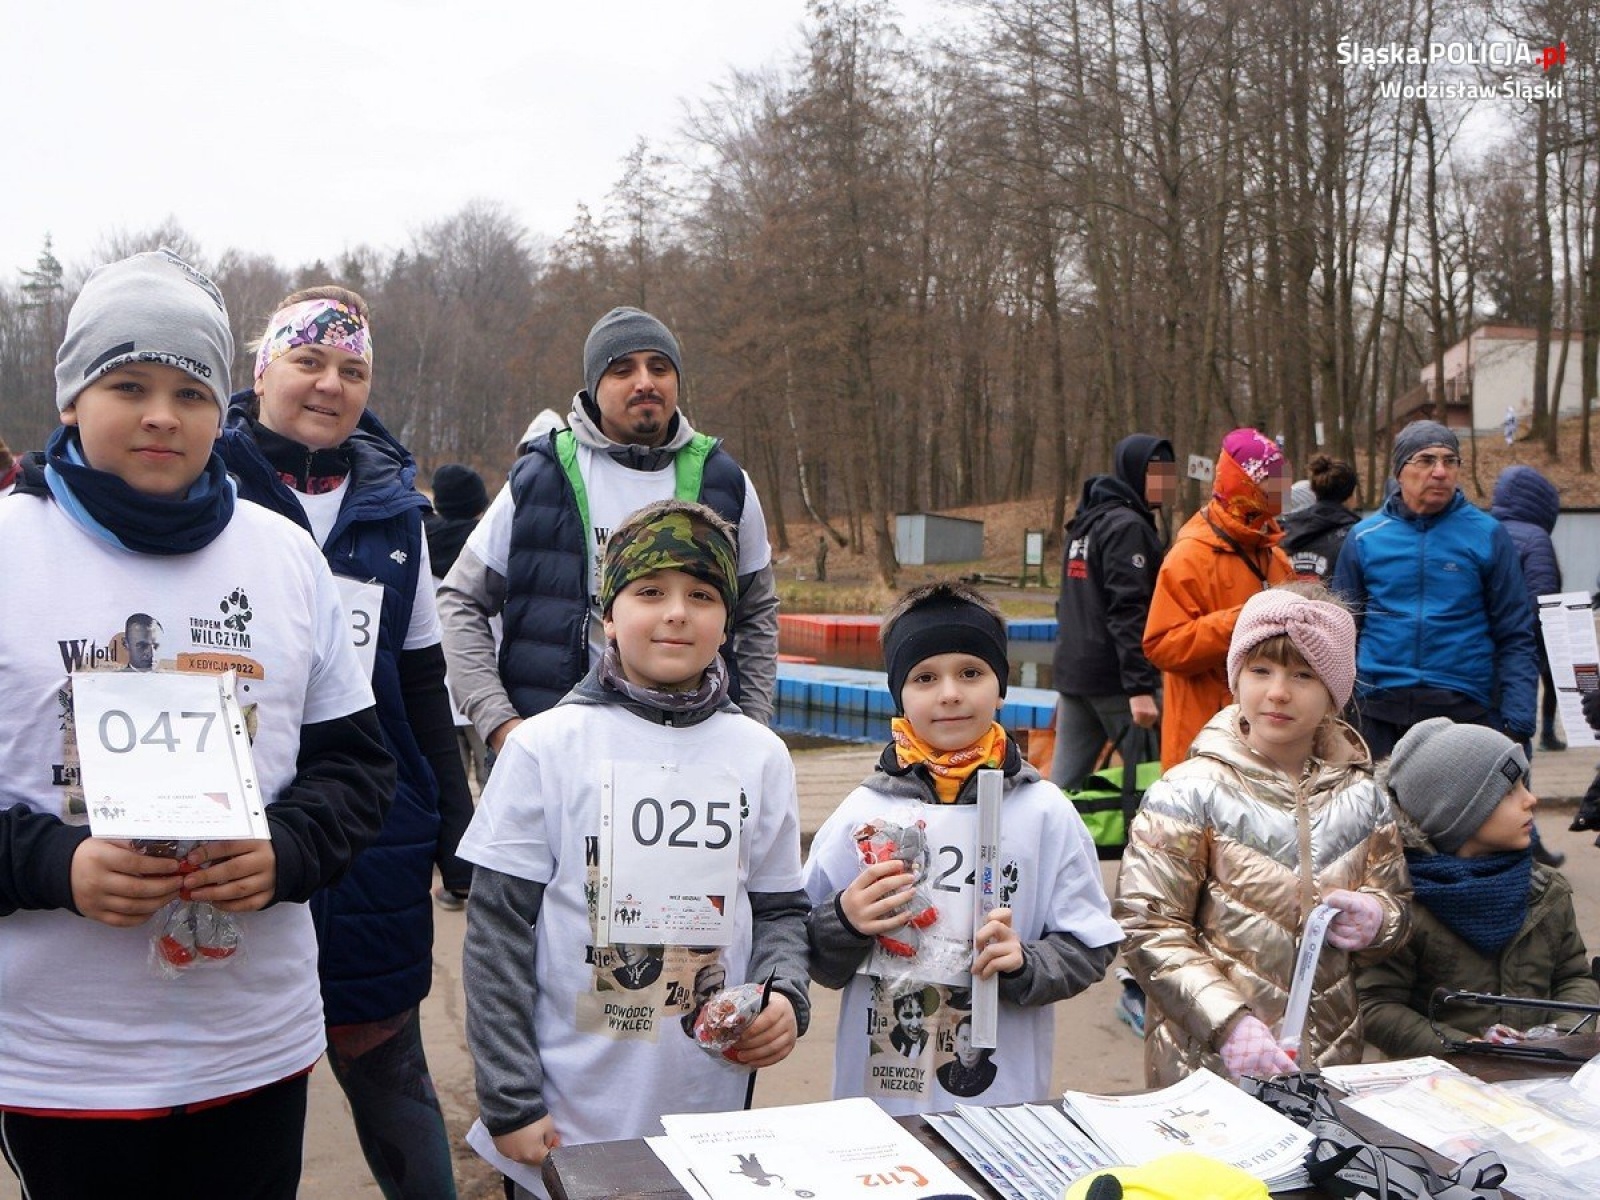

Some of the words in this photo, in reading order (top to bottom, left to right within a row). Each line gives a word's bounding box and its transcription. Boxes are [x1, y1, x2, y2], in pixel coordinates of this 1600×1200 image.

[190, 617, 221, 629] TROPEM
[191, 628, 251, 649] WILCZYM
[58, 639, 117, 673] Witold
[188, 659, 196, 669] X
[197, 660, 229, 671] EDYCJA
[230, 663, 254, 674] 2022
[98, 710, 217, 753] 047
[631, 797, 732, 849] 025
[604, 1003, 655, 1018] DOWÓDCY
[609, 1016, 653, 1032] WYKLĘCI
[856, 1172, 905, 1188] 112
